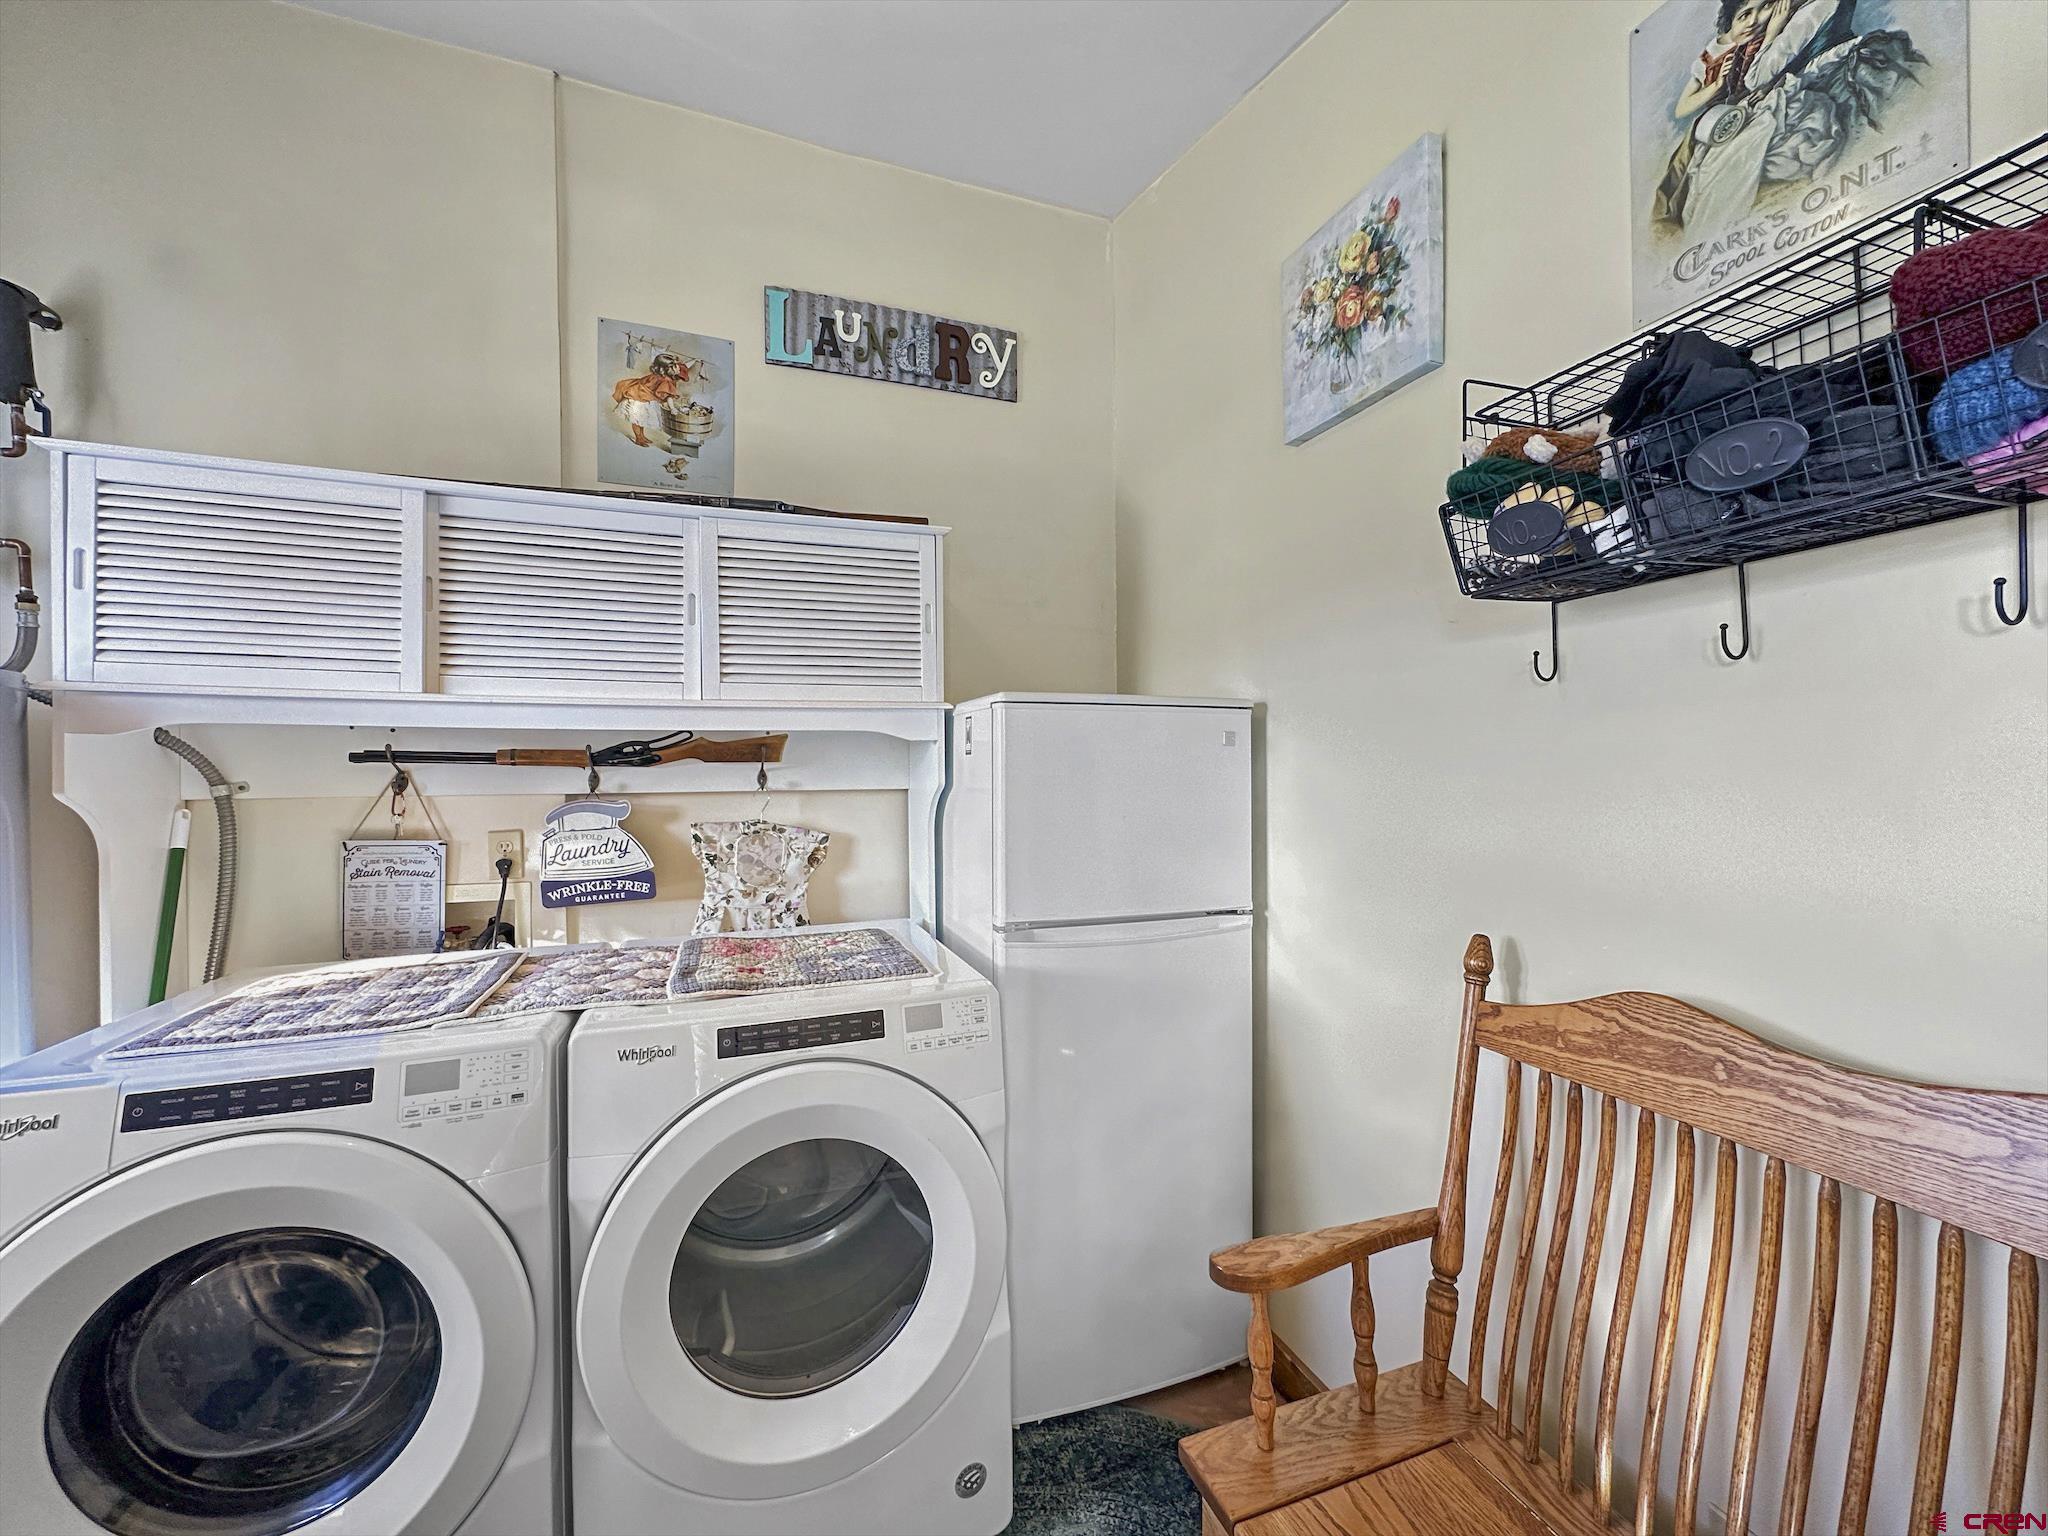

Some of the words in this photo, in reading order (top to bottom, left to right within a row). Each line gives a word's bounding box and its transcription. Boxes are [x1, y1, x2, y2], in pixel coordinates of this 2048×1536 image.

[1800, 146, 1906, 213] O.N.T.
[1708, 244, 1766, 288] SPOOL
[1773, 204, 1850, 250] COTTON
[547, 837, 631, 867] Laundry
[582, 858, 616, 867] SERVICE
[350, 868, 383, 881] Stain
[385, 866, 436, 879] Removal
[547, 880, 651, 902] WRINKLE-FREE
[575, 892, 626, 903] GUARANTEE
[617, 1044, 677, 1066] Whirlpool
[0, 1114, 60, 1140] irlpool
